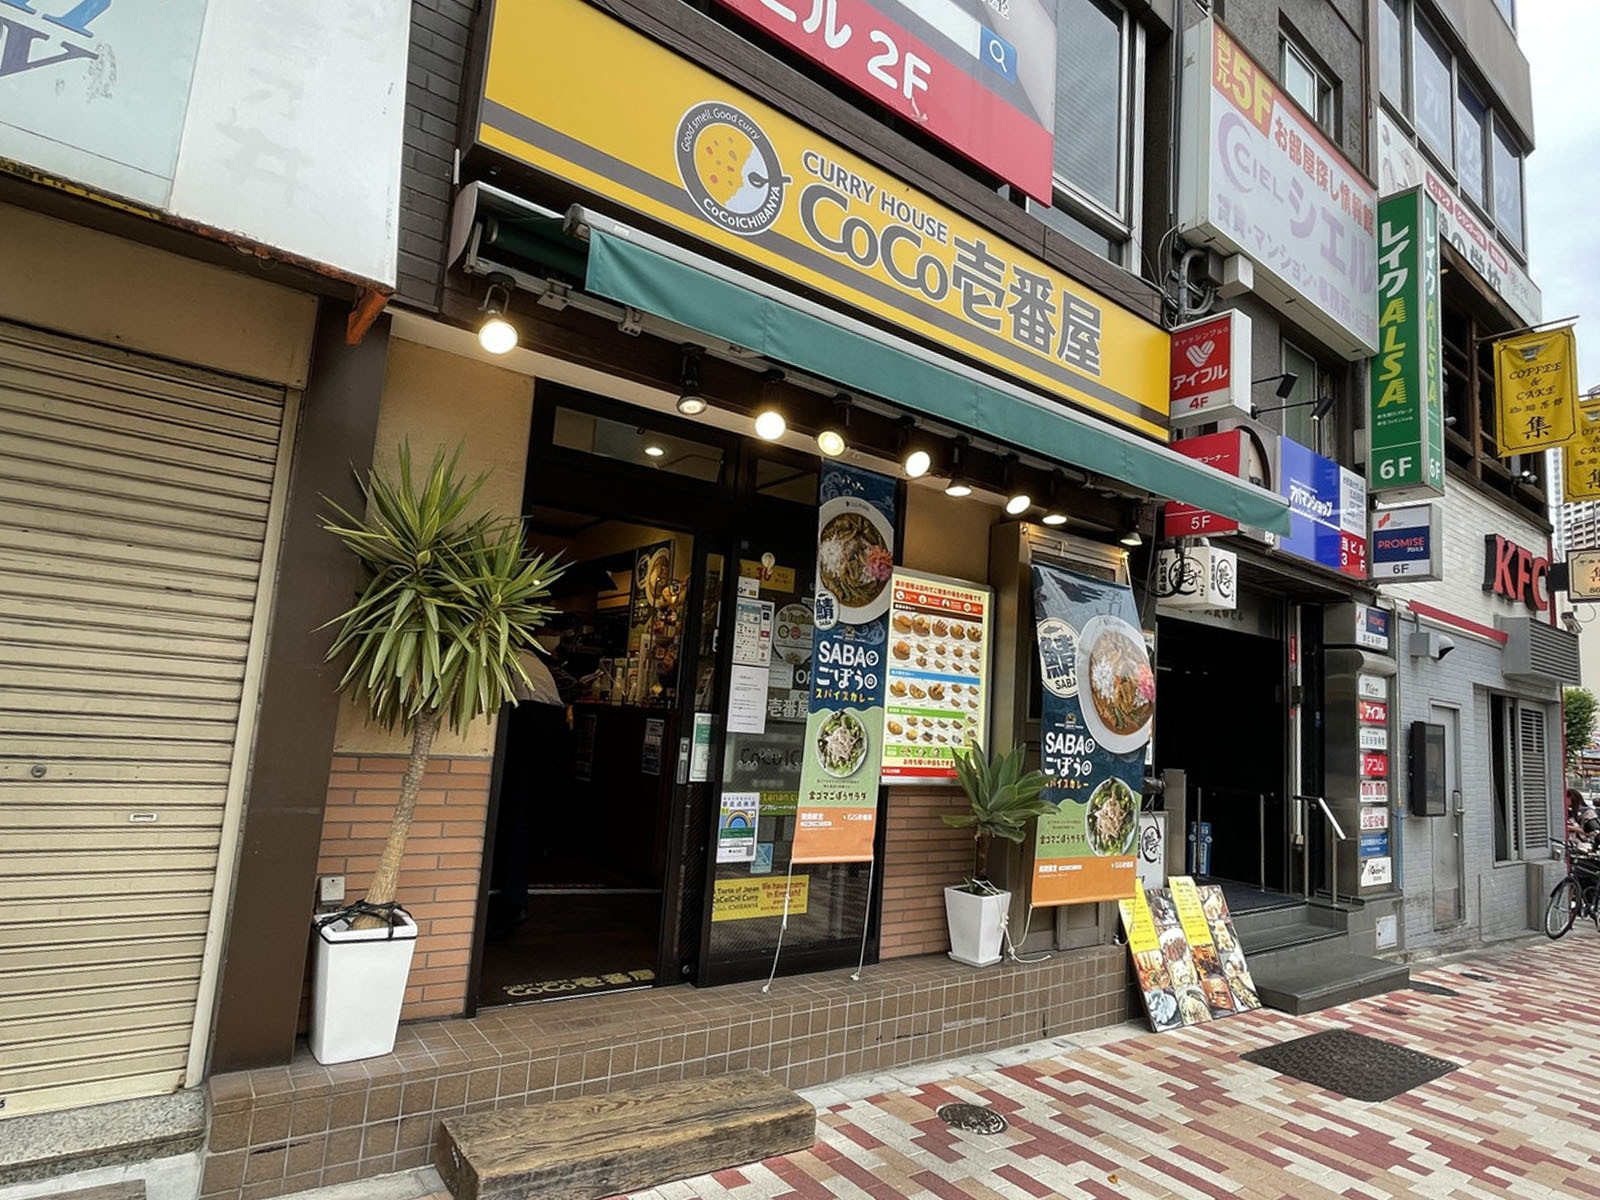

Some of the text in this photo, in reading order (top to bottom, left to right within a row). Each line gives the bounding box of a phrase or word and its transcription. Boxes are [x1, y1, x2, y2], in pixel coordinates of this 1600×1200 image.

[866, 30, 932, 99] 2F
[1232, 51, 1274, 124] 5F
[680, 124, 695, 152] Good
[712, 107, 739, 123] Good
[737, 118, 760, 140] curry
[1233, 142, 1285, 204] CIEL
[703, 186, 780, 229] CoCoICHIBANYA
[802, 150, 950, 245] CURRY HOUSE
[1287, 175, 1375, 295] シエル
[798, 182, 1103, 378] CoCo壱番屋
[1172, 364, 1229, 392] アイフル
[1509, 361, 1563, 381] COFFEE
[1530, 377, 1542, 387] &
[1189, 396, 1209, 409] 4F
[1515, 385, 1556, 401] CAKE
[1522, 415, 1553, 440] 集
[1380, 456, 1412, 480] 6F
[1429, 457, 1441, 480] 6F
[1190, 514, 1212, 530] 5F
[1341, 536, 1366, 558] 当ビル
[1377, 536, 1425, 550] PROMISE
[1392, 563, 1411, 575] 6F
[1483, 533, 1549, 612] KFC
[1054, 677, 1077, 690] SABA
[815, 688, 876, 703] スパイスカレー
[742, 885, 760, 895] Japan
[742, 894, 759, 903] Curry
